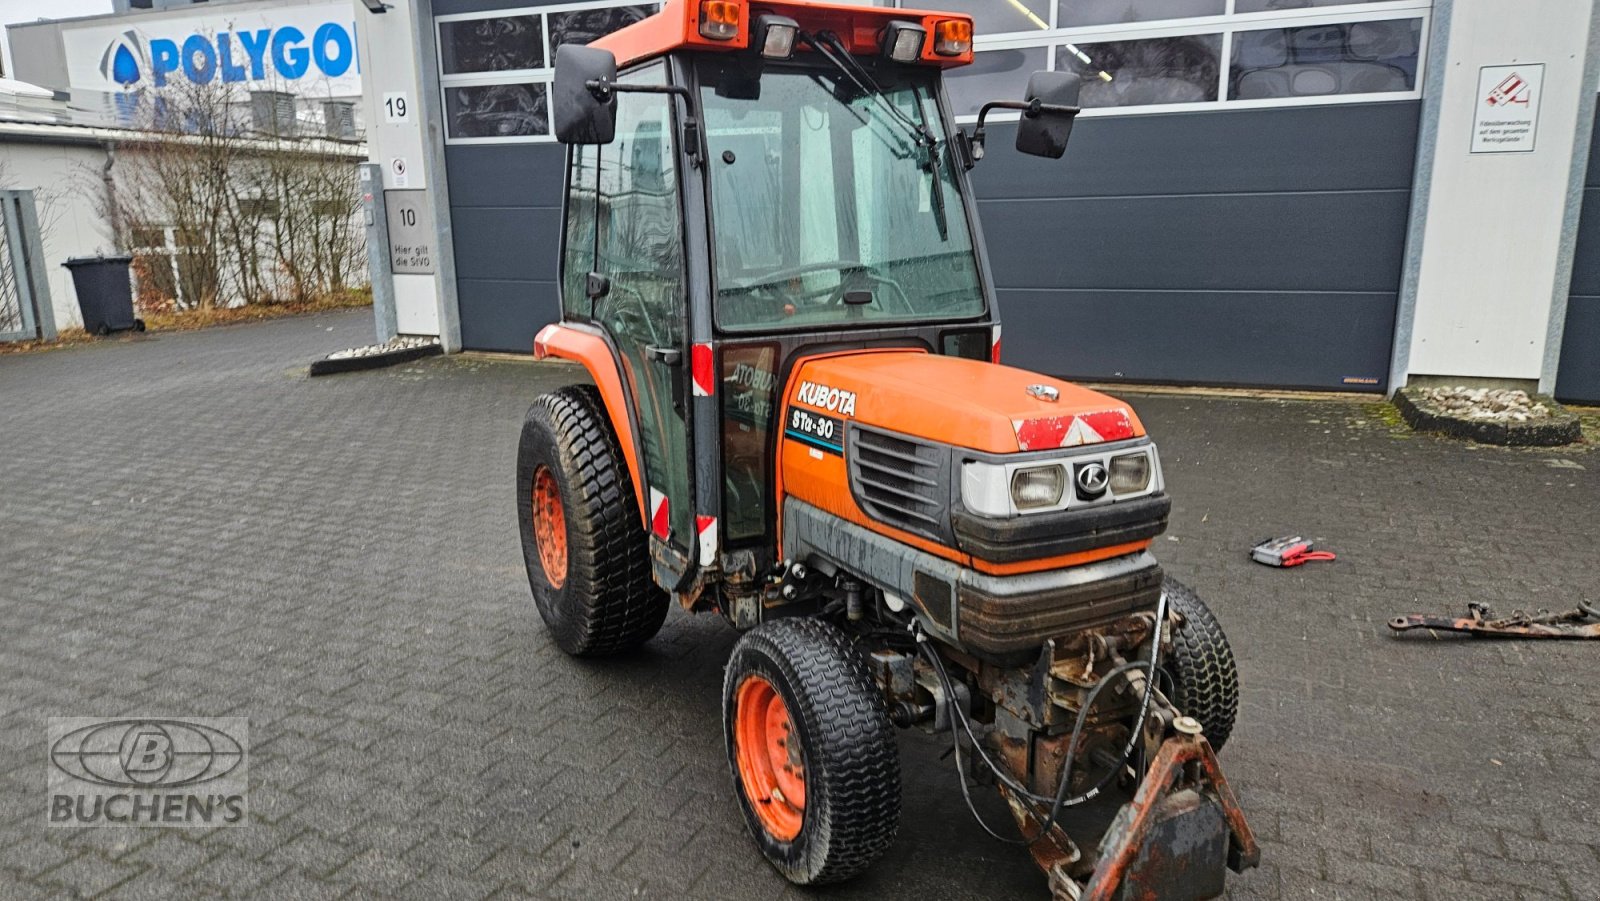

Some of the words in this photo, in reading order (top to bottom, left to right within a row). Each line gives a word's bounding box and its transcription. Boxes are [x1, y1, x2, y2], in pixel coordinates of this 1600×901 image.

[150, 22, 360, 88] POLYGO
[385, 97, 406, 117] 19
[400, 209, 415, 226] 10
[395, 244, 411, 254] Hier
[415, 245, 428, 256] gilt
[396, 256, 408, 266] die
[798, 381, 856, 416] KUBOTA
